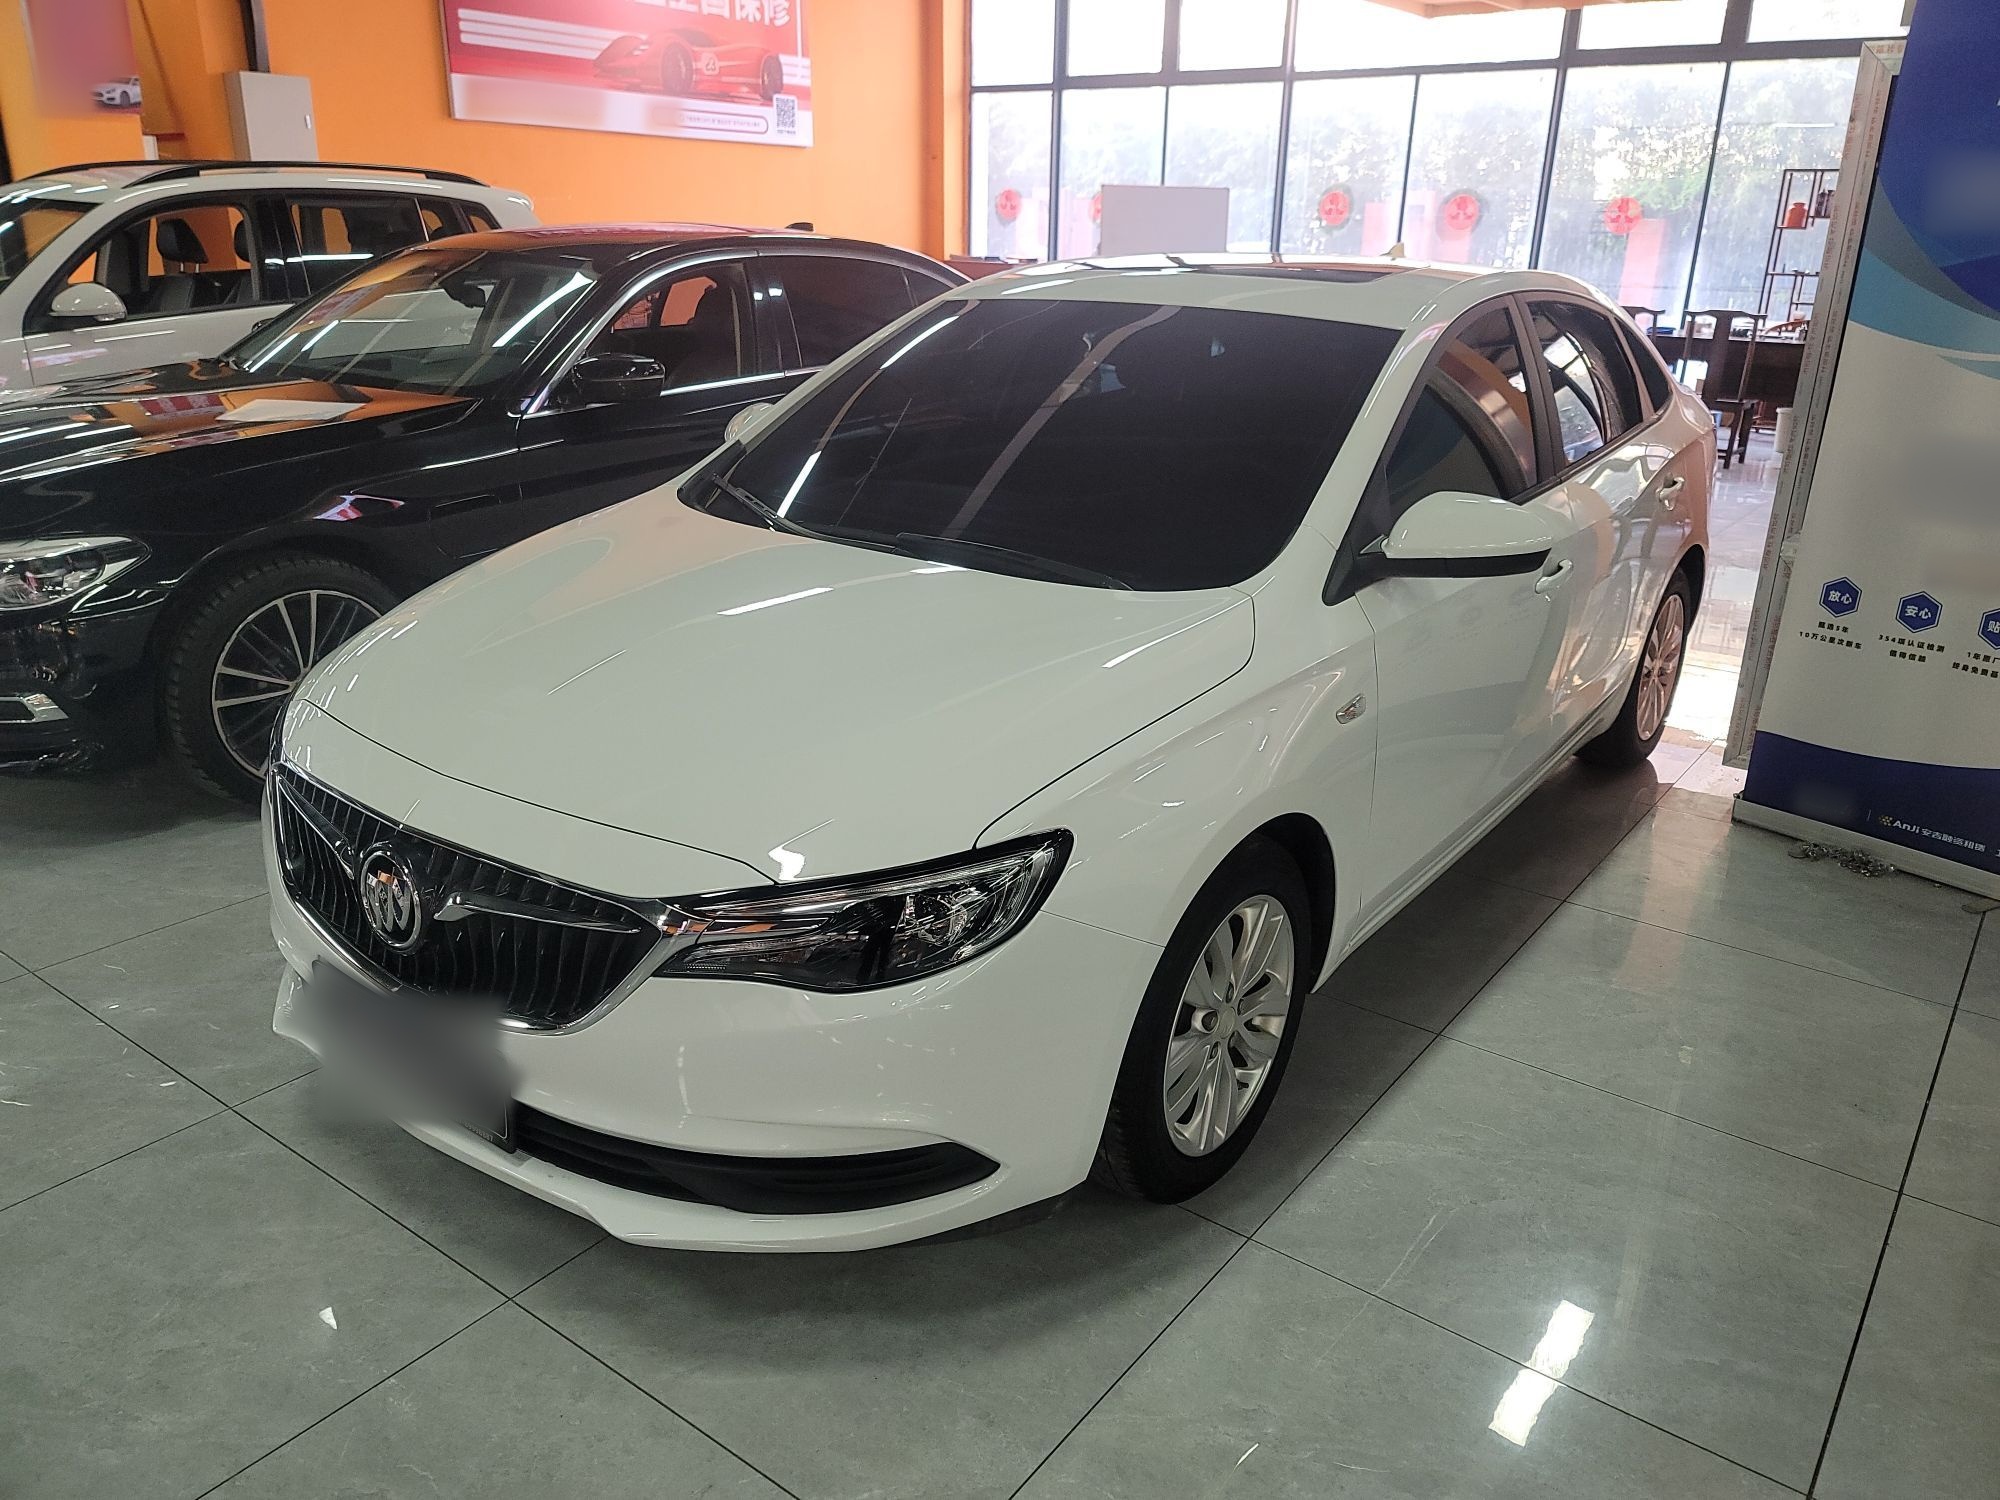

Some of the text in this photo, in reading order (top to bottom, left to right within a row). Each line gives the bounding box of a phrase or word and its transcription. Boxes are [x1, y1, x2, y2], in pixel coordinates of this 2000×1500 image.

[1828, 590, 1852, 604] 放心
[1904, 605, 1931, 619] 安心
[1799, 631, 1863, 650] 10万公里次新车
[1921, 828, 1987, 852] 安吉融资租赁
